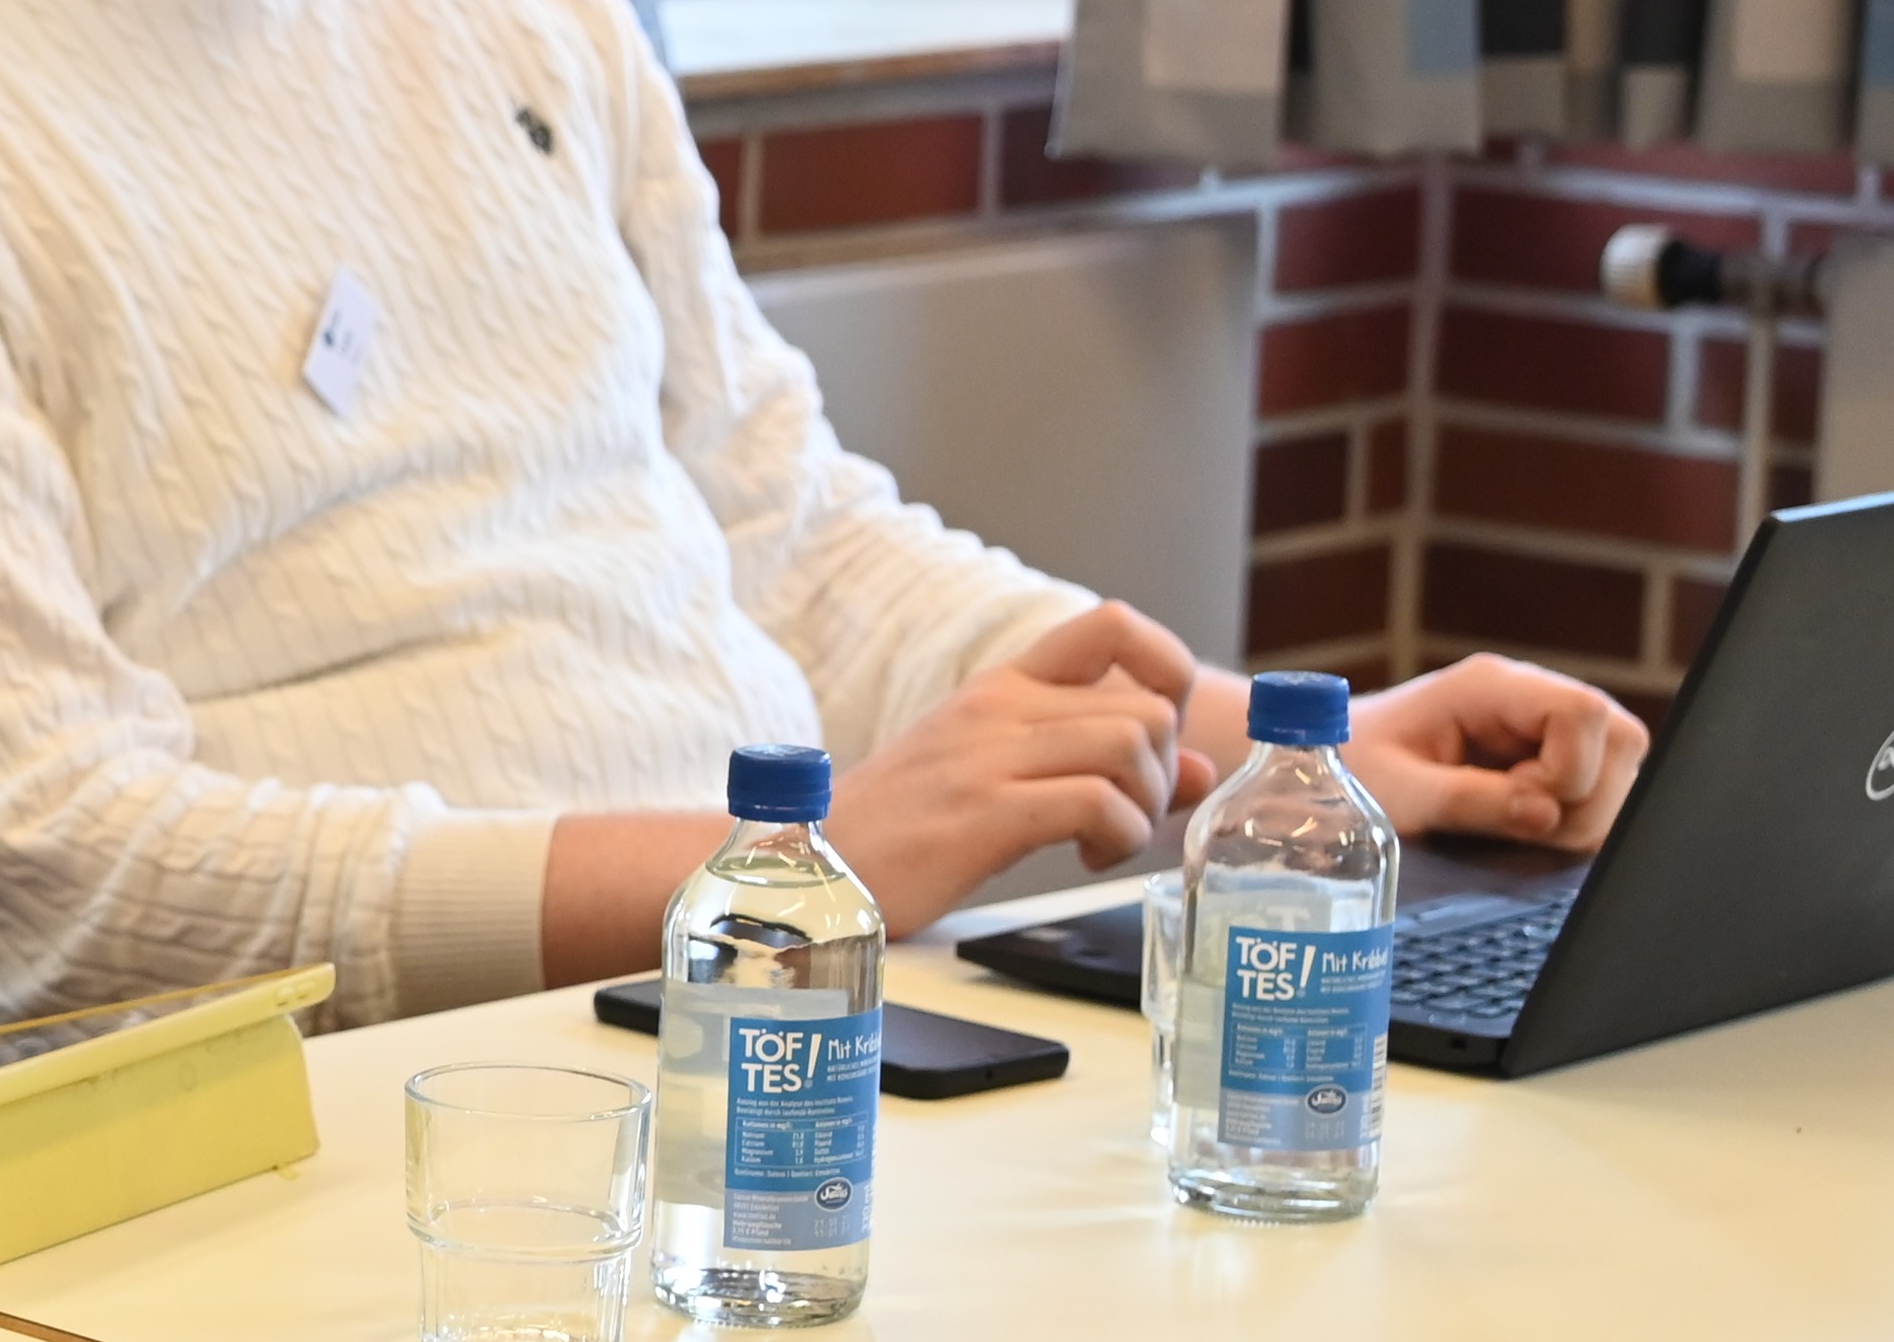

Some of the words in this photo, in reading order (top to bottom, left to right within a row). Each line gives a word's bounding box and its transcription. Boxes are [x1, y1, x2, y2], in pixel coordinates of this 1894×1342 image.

[1235, 936, 1297, 971] TÖF
[1322, 951, 1348, 974] Mit
[738, 1028, 804, 1063] TÖF
[827, 1038, 852, 1061] Mit
